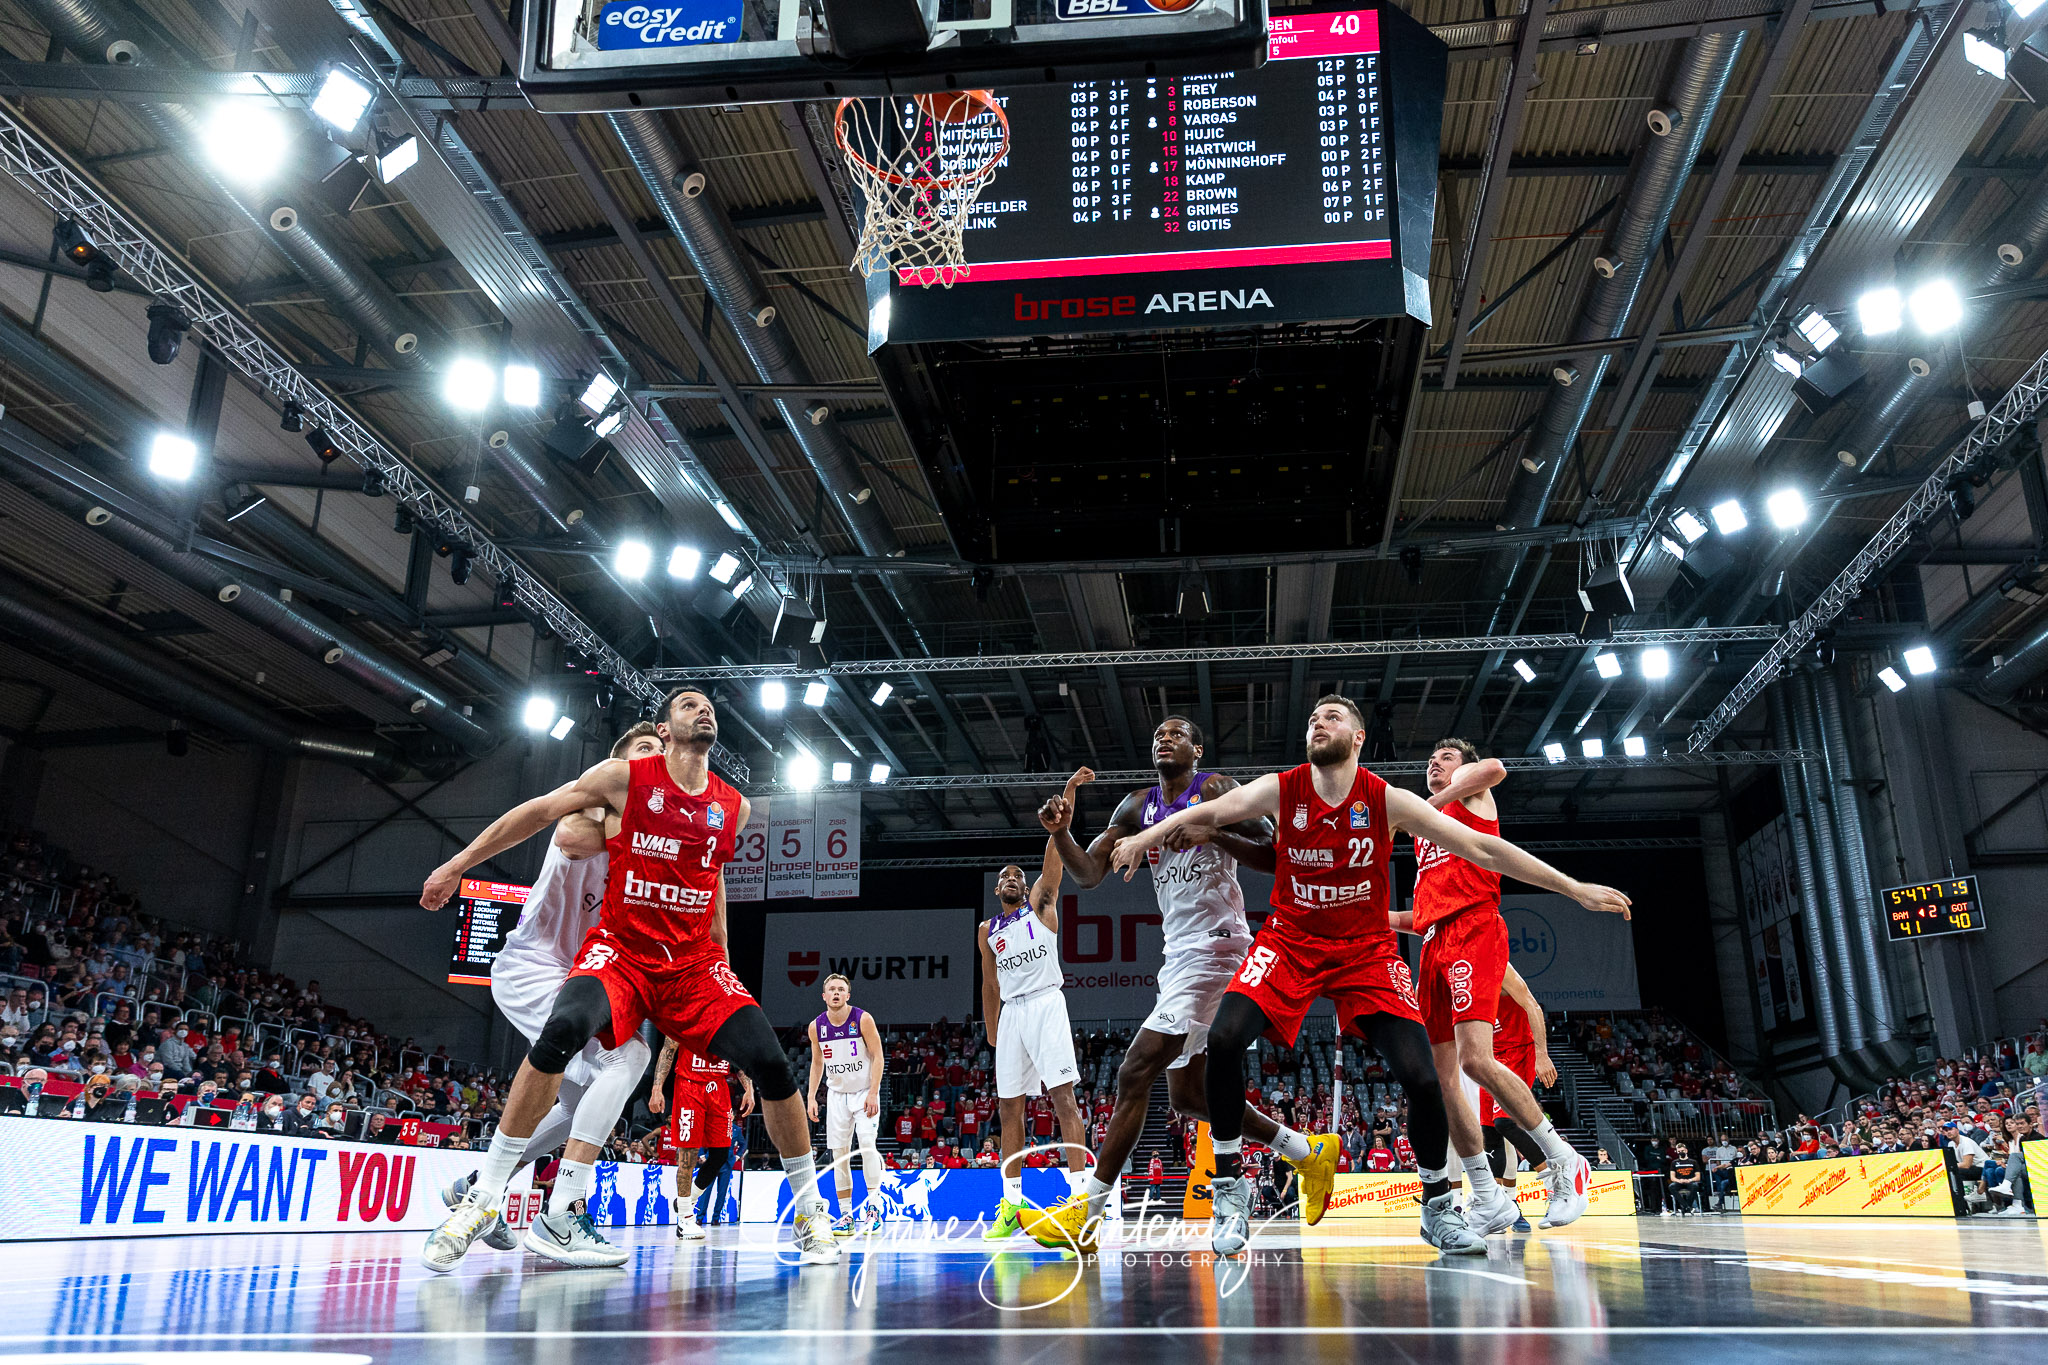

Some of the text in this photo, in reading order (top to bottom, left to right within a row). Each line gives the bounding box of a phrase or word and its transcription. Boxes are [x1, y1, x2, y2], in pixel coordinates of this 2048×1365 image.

[1330, 14, 1360, 35] 40
[1269, 35, 1298, 44] mfoul
[1273, 46, 1280, 56] 5
[1318, 58, 1375, 71] 12 P 2 F
[1168, 73, 1376, 97] 3 FREY 05 P 0 F
[1169, 87, 1377, 111] 5 ROBERSON 04 P 3 F
[925, 113, 996, 127] 4 WITT
[1169, 102, 1378, 126] 8 VARGAS 03 P 0 F
[925, 127, 1004, 142] 8 MITCHELL
[1163, 118, 1379, 141] 10 HUJIC 03 P 1 F
[919, 147, 931, 157] 11
[1163, 141, 1255, 156] 15 HARTWICH
[920, 156, 1008, 172] 2 ROBINSN
[1164, 154, 1286, 171] 17 MÖNNINGHOFF
[1164, 174, 1225, 186] 18 KAMP
[1164, 188, 1236, 202] 22 BROWN
[940, 200, 1028, 216] SEGFELDER
[1164, 203, 1238, 217] 24 GRIMES
[940, 217, 996, 230] LINK
[1164, 219, 1231, 232] 32 GIOTIS
[1014, 288, 1274, 321] brose ARENA
[632, 832, 665, 851] LVM
[734, 832, 766, 862] 23
[781, 829, 801, 858] 5
[827, 829, 847, 858] 6
[632, 848, 677, 861] VERSICHERUNG
[701, 836, 717, 868] 3
[1288, 848, 1318, 861] LVM
[1348, 837, 1374, 868] 22
[724, 864, 764, 875] brose
[770, 861, 811, 872] brose
[816, 861, 858, 872] brose
[770, 871, 811, 881] baskets
[816, 872, 858, 880] bamberg
[468, 881, 480, 890] 41
[624, 870, 712, 905] brose
[1291, 875, 1371, 902] brose
[1932, 884, 1942, 898] 7
[1892, 902, 1968, 920] BAM 2 GOT
[1026, 921, 1034, 940] 1
[1900, 913, 1971, 935] 41 40
[1509, 928, 1547, 953] ebi
[1064, 972, 1158, 989] Excellenc
[1535, 988, 1605, 1000] omponents
[850, 1041, 857, 1056] 3
[402, 1122, 417, 1136] 5 5
[80, 1135, 416, 1224] WE WANT YOU
[1365, 1180, 1389, 1189] Strömen
[1870, 1180, 1895, 1205] elektro
[1894, 1161, 1924, 1188] wittner
[1601, 1184, 1626, 1194] Bamberg
[1328, 1192, 1374, 1210] elektro
